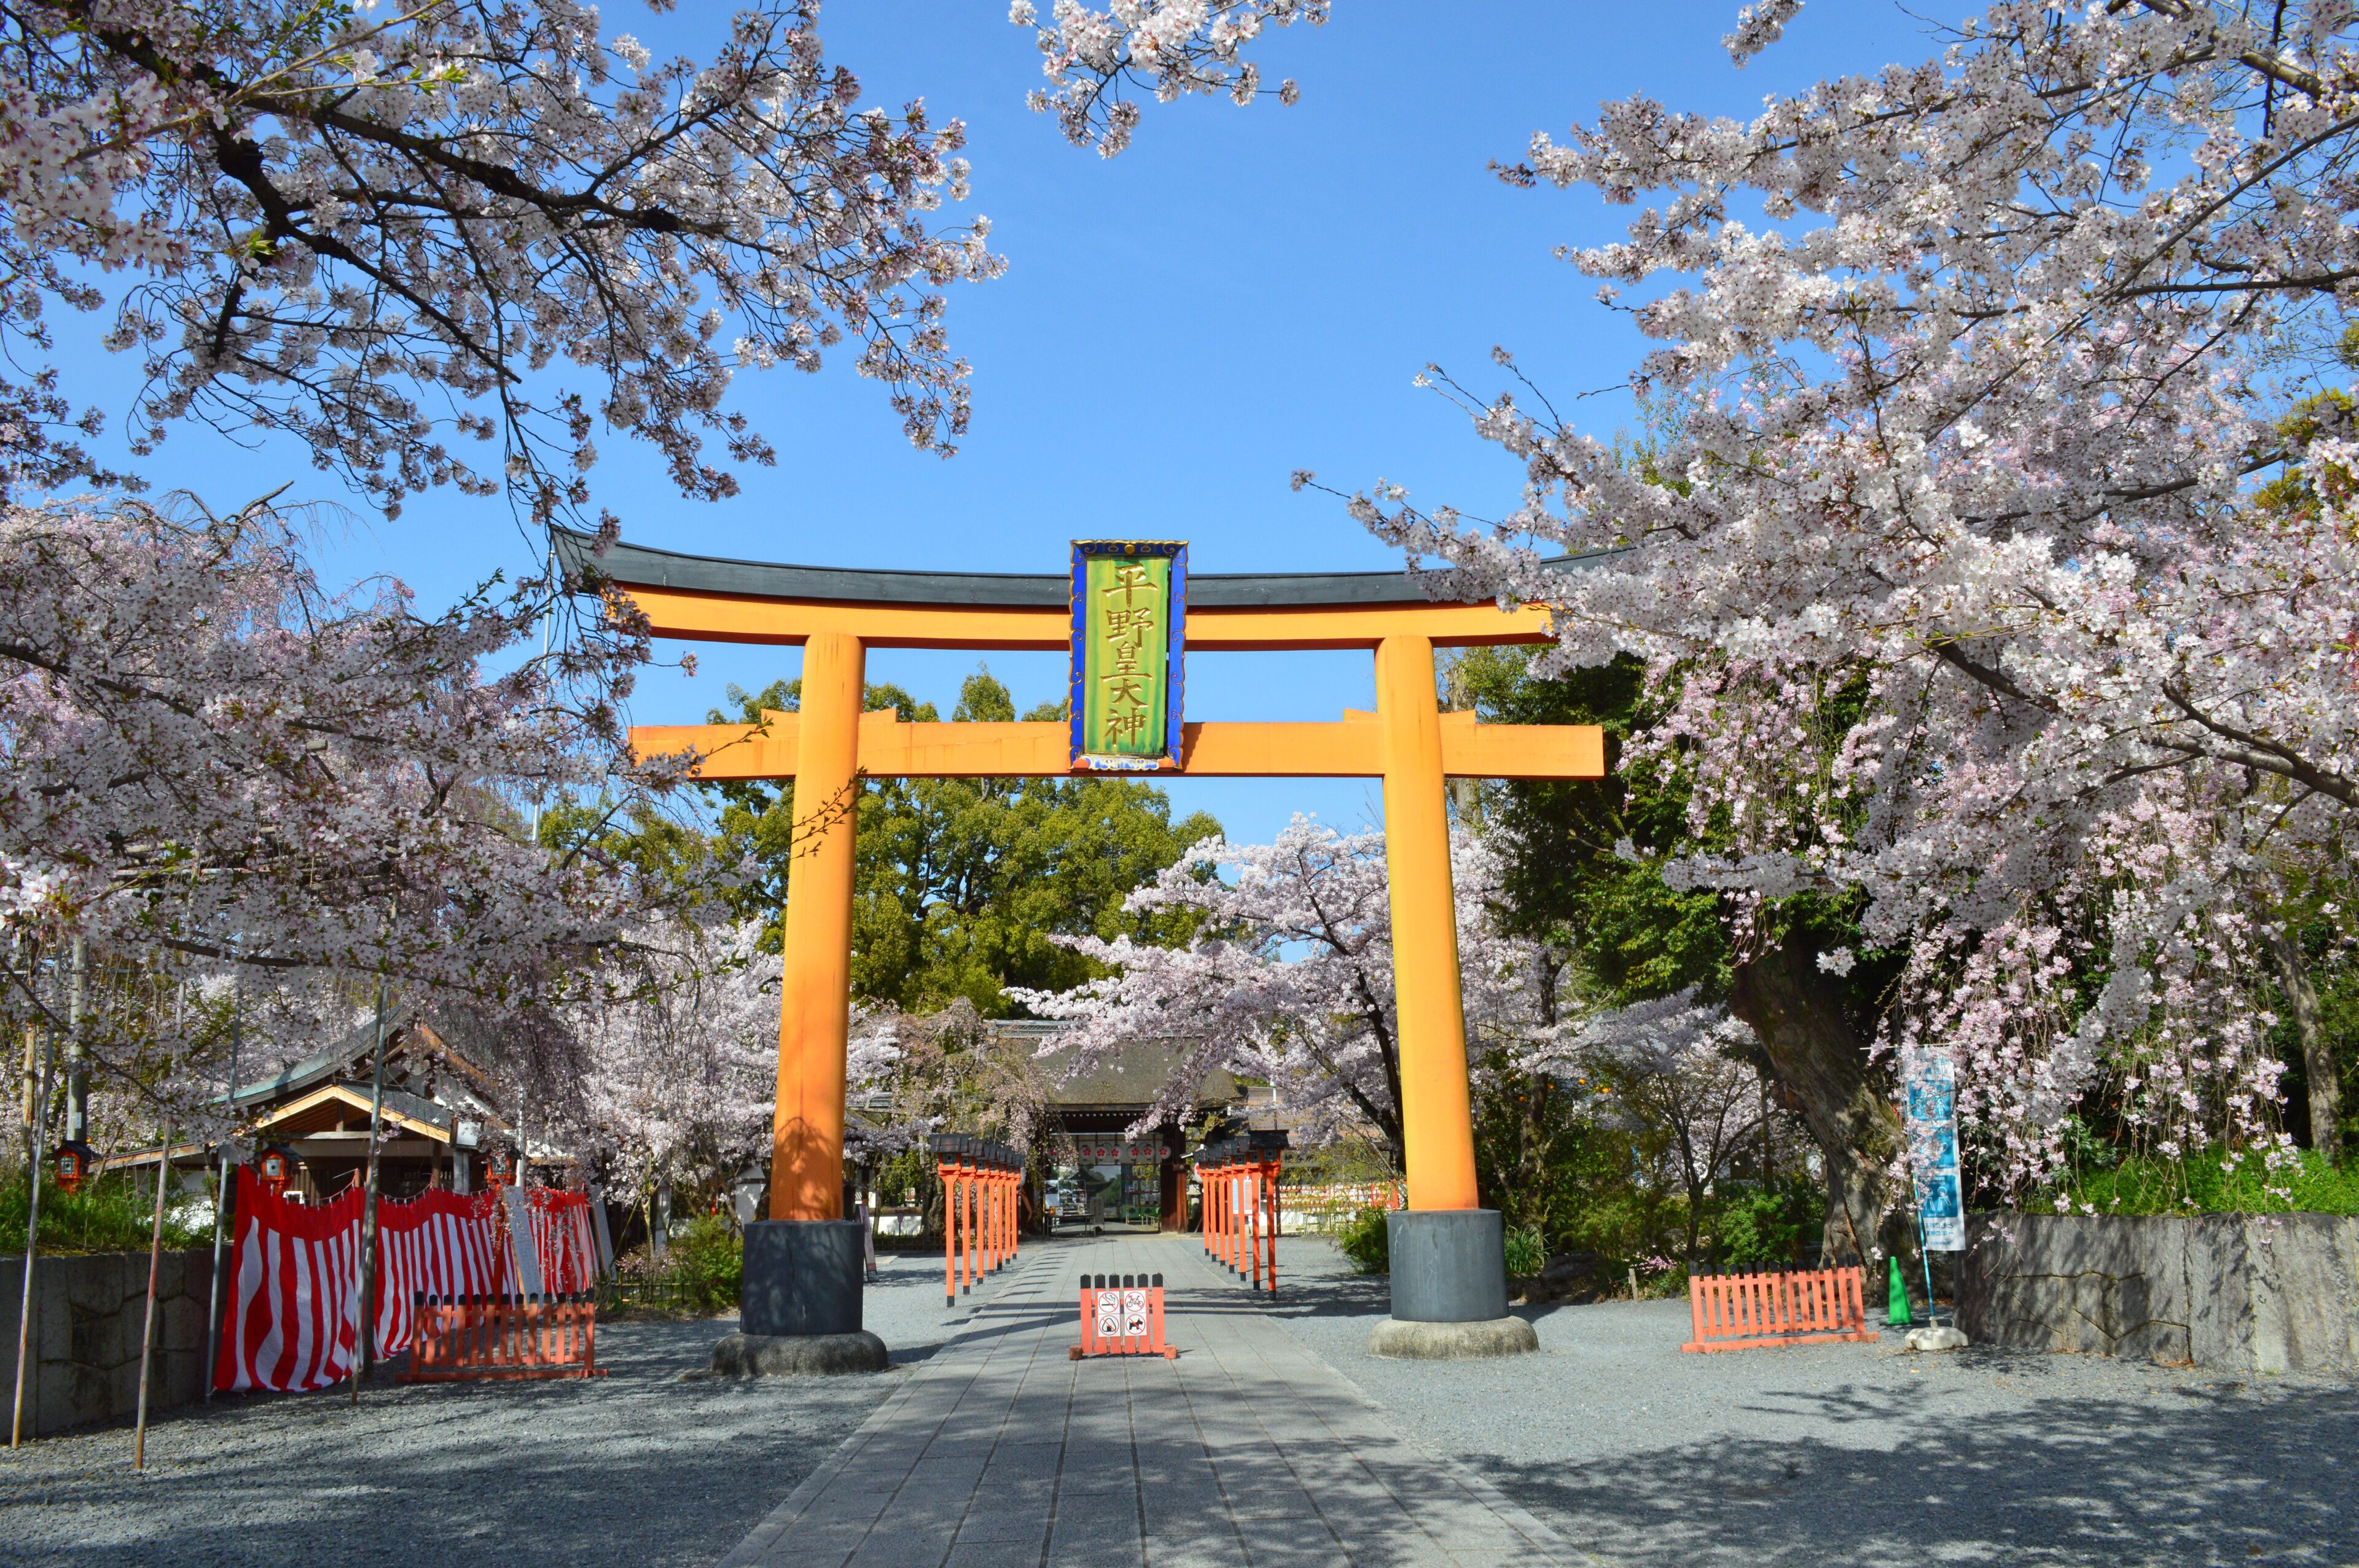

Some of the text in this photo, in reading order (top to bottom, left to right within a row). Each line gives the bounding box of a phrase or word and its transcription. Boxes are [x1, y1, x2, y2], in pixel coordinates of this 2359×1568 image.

[1100, 562, 1159, 749] 平野皇大神
